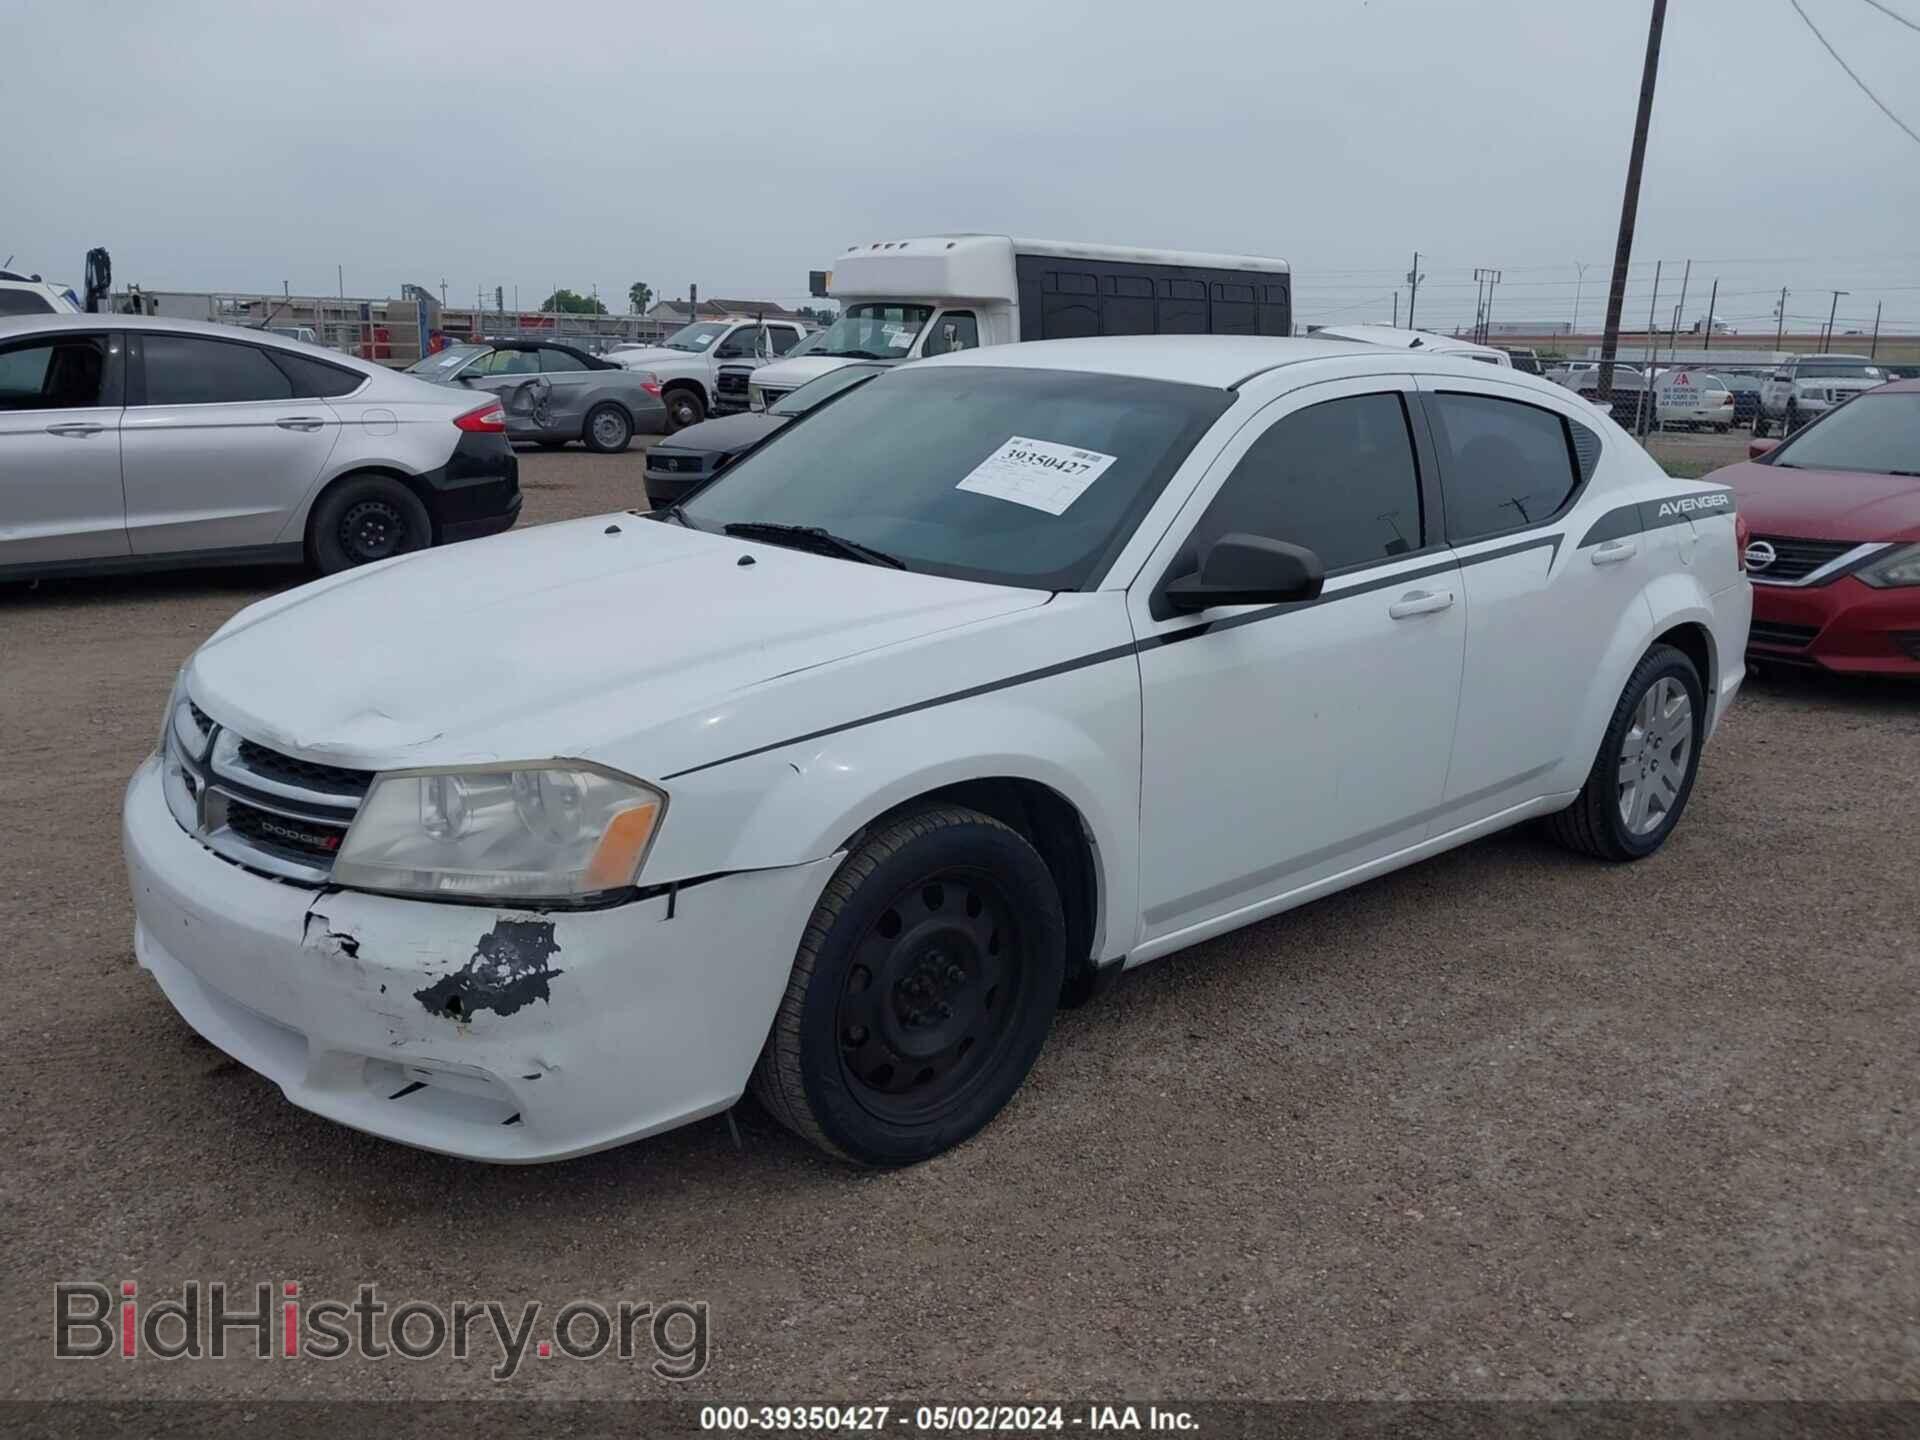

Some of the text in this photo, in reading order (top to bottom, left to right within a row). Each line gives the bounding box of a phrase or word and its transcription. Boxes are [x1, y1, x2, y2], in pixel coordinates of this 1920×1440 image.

[1001, 448, 1091, 476] 39350427
[1658, 494, 1729, 517] AVENGER
[262, 821, 329, 848] DODGE
